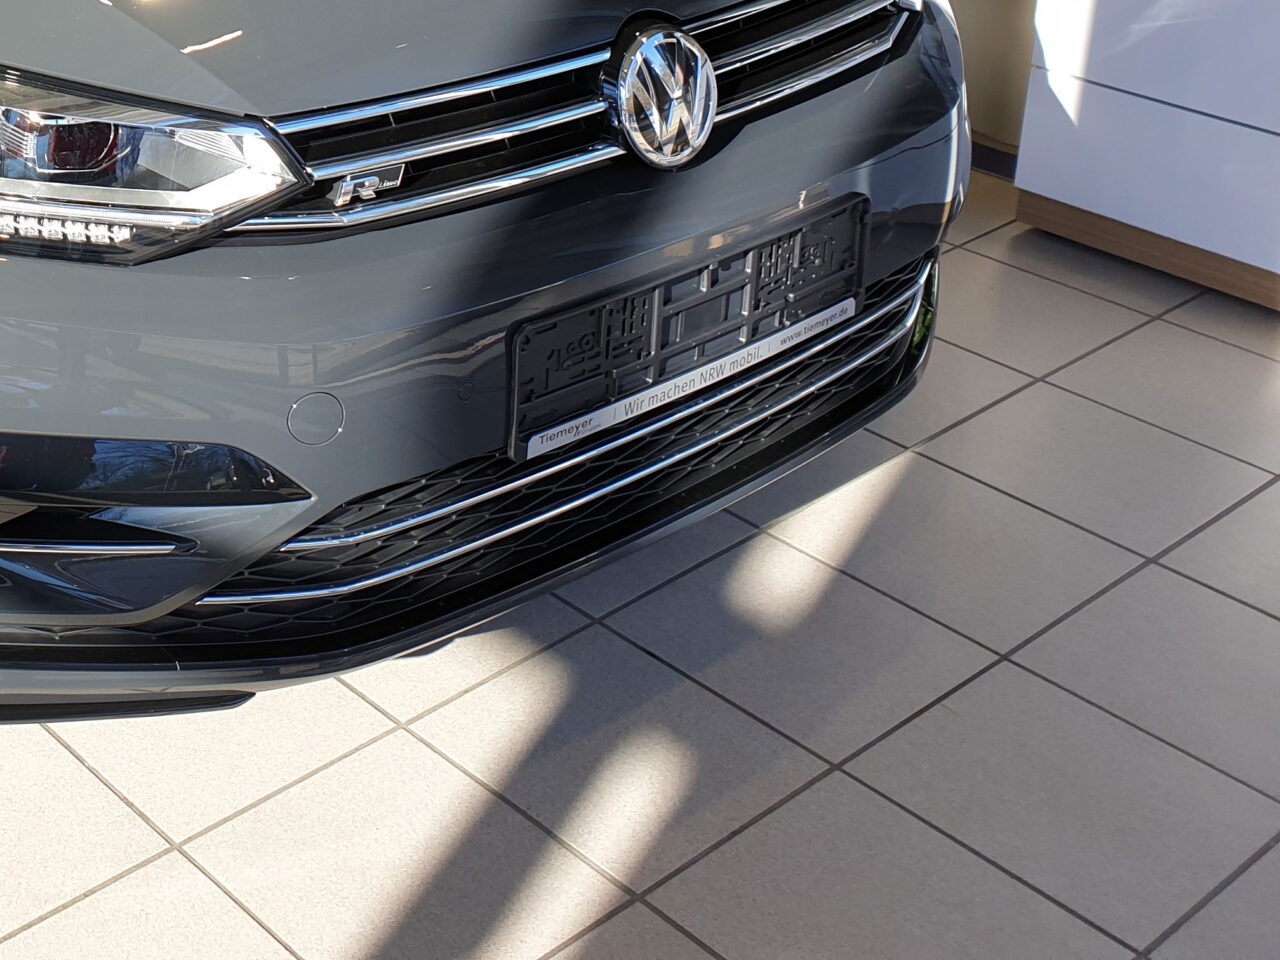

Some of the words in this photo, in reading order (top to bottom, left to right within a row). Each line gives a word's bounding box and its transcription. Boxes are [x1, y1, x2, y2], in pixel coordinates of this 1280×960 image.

[539, 418, 593, 445] Tiemeyer
[624, 398, 645, 417] Wir
[648, 378, 696, 407] machen
[699, 363, 727, 386] NRW
[729, 346, 764, 374] mobil.
[780, 306, 849, 346] www.tiemeyer.de
